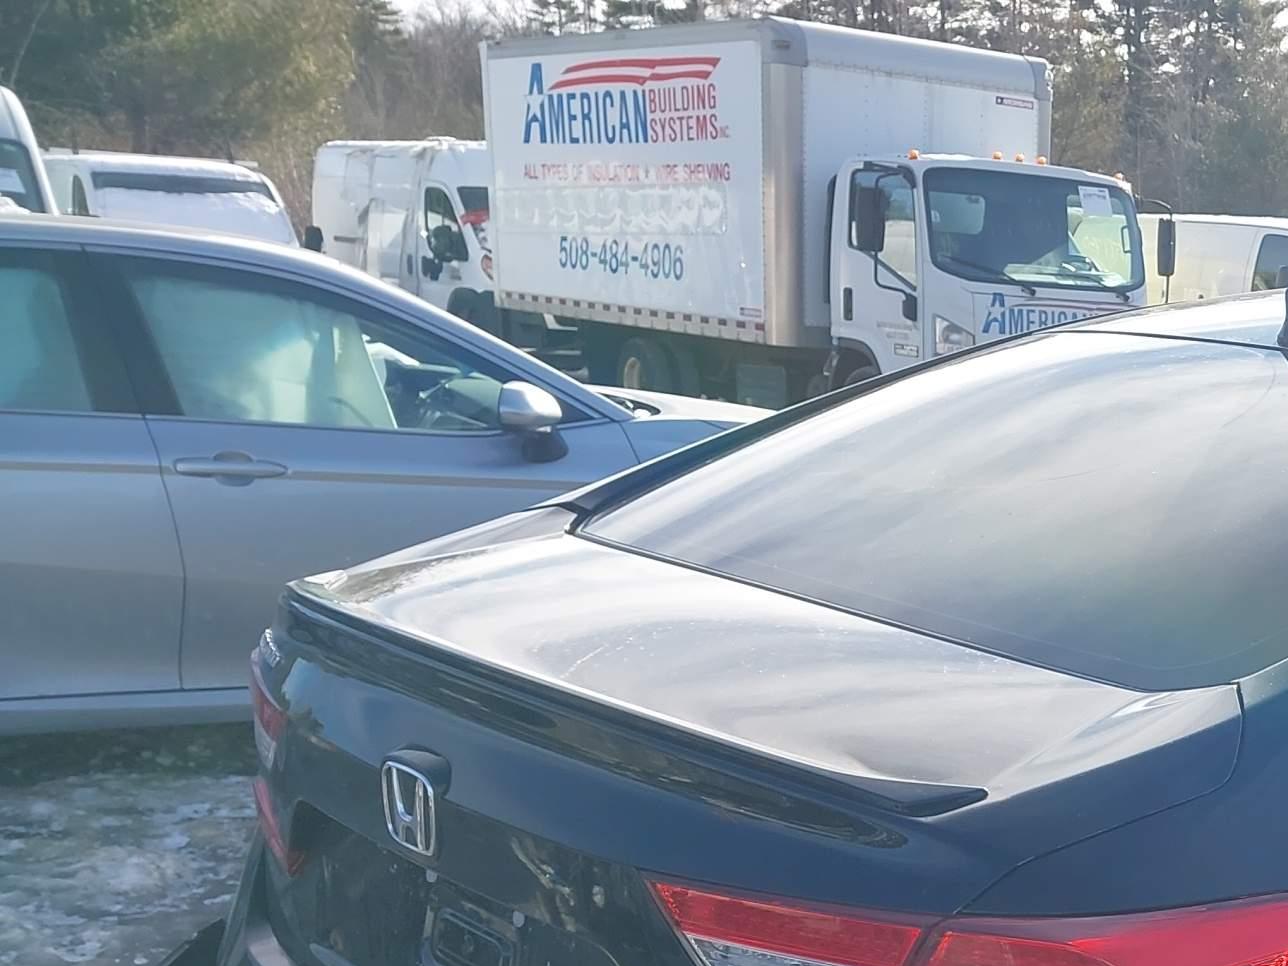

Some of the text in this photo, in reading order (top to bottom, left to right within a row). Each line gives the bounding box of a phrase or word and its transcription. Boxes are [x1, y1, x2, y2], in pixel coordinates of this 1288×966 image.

[523, 62, 648, 144] AMERICAN
[649, 83, 716, 114] BUILDING
[650, 113, 719, 143] SYSTEMS
[524, 164, 538, 180] ALL
[683, 162, 731, 181] SHELVING
[559, 236, 684, 280] 508-484-4906
